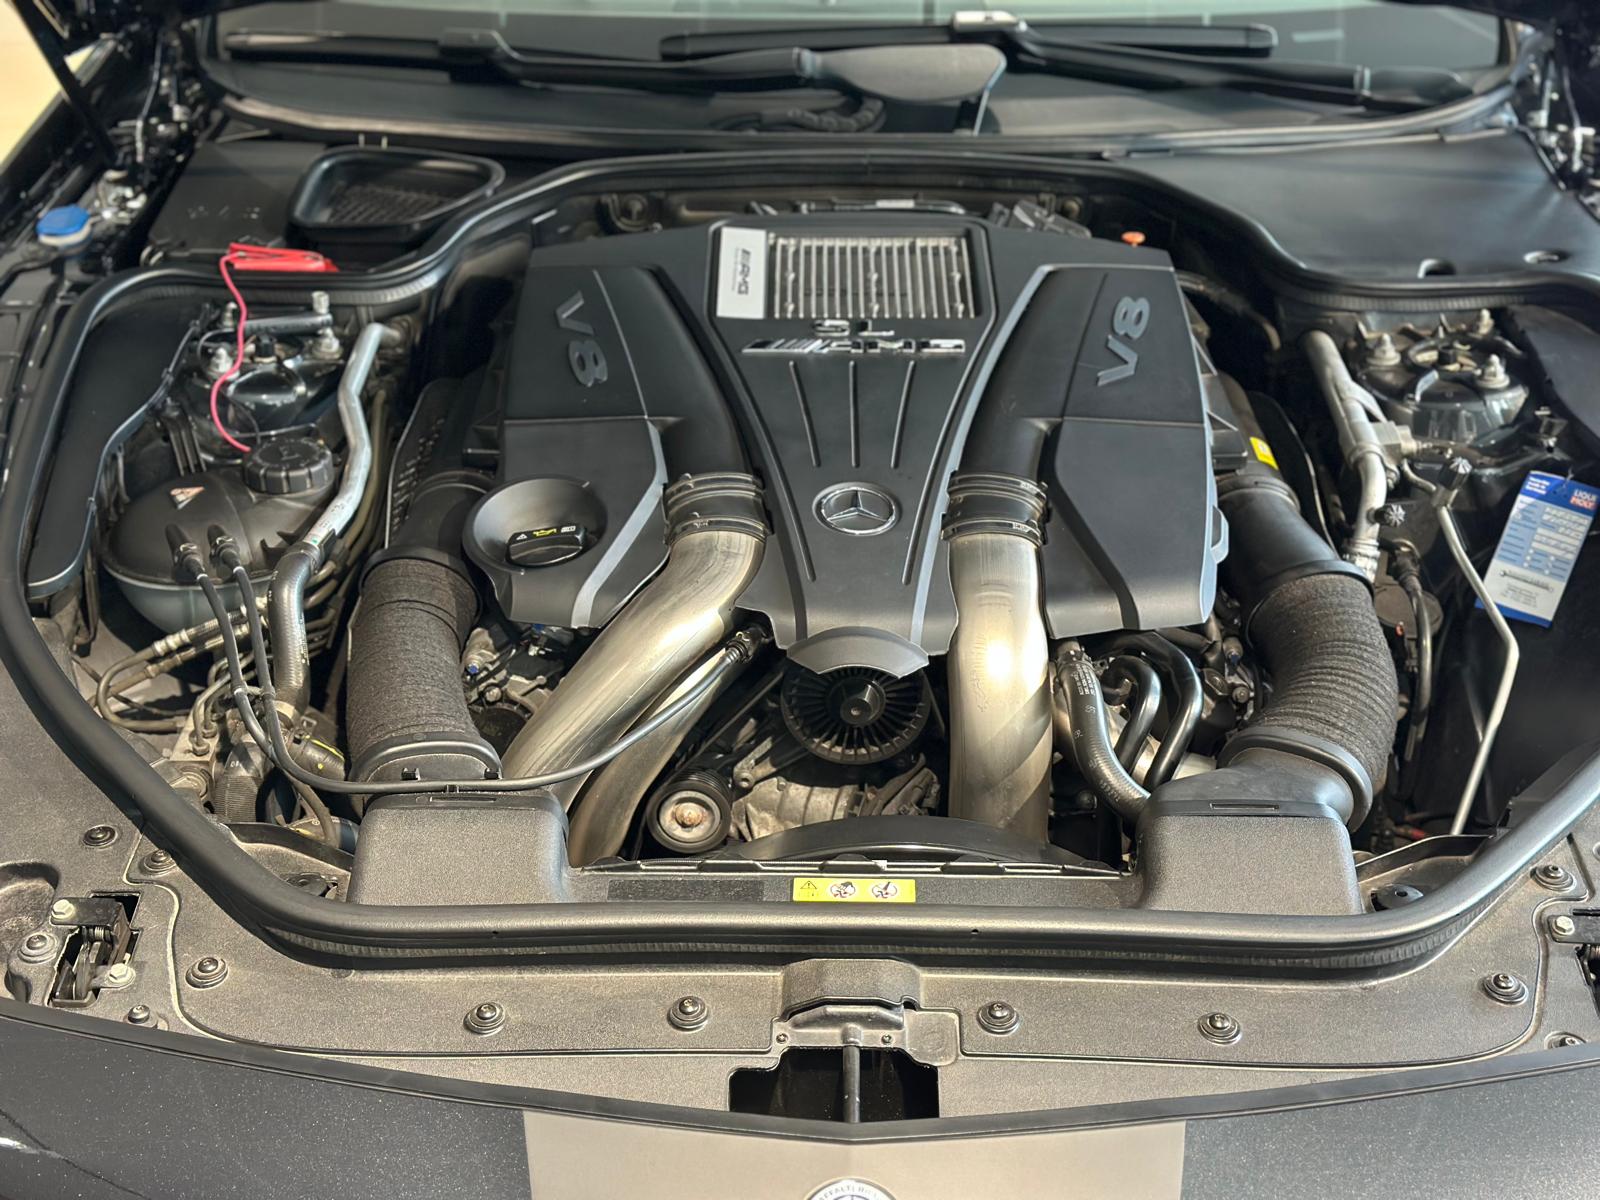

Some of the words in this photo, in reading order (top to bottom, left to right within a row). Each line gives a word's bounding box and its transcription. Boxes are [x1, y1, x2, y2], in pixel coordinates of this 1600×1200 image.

[555, 289, 609, 388] V8
[1096, 295, 1151, 388] V8
[1570, 496, 1597, 511] MOLY
